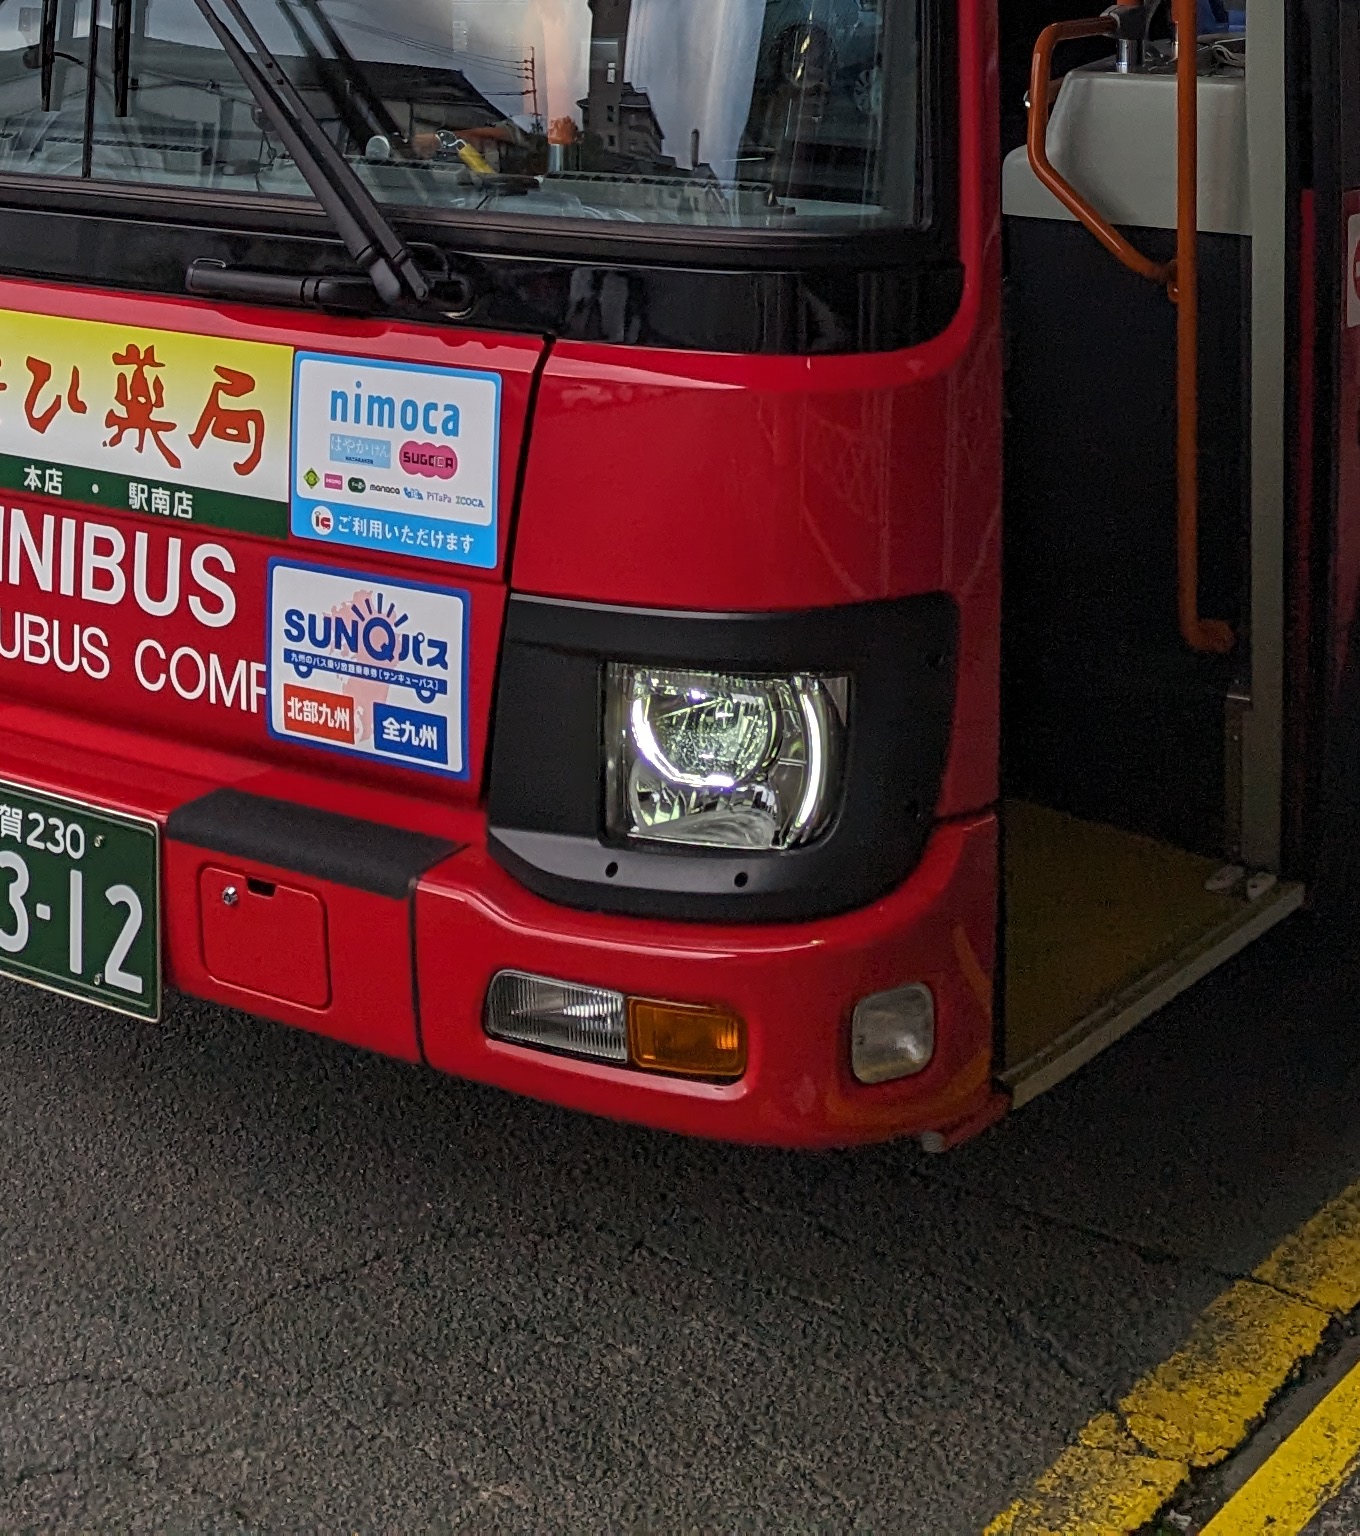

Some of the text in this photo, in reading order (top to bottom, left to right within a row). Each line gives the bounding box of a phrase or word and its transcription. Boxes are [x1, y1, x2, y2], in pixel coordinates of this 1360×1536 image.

[330, 380, 460, 437] nimoca
[403, 451, 454, 469] SUGOCA
[23, 465, 63, 495] 本店
[128, 481, 193, 519] 駅南店
[369, 484, 400, 495] manaca
[426, 491, 452, 503] PiTaPa
[455, 495, 485, 508] ICOCA
[338, 515, 474, 554] ご利用いただけます
[286, 696, 350, 731] 北部九州
[382, 716, 438, 750] 全九州
